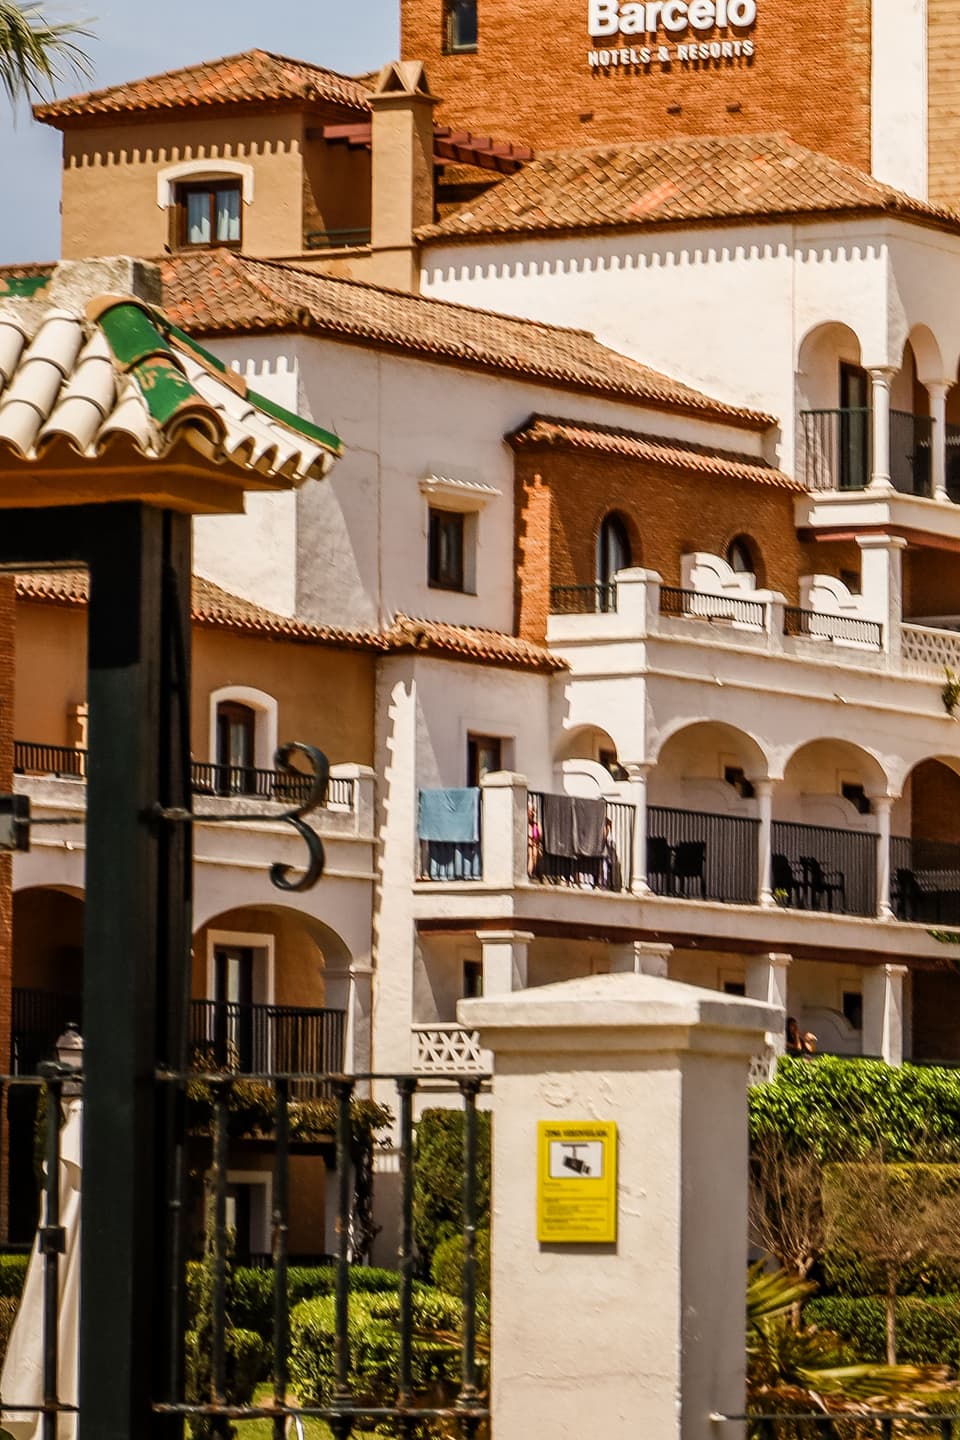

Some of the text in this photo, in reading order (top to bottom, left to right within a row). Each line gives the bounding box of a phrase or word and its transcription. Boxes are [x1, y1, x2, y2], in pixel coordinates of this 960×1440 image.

[588, 39, 754, 67] HOTELS & RESORTS
